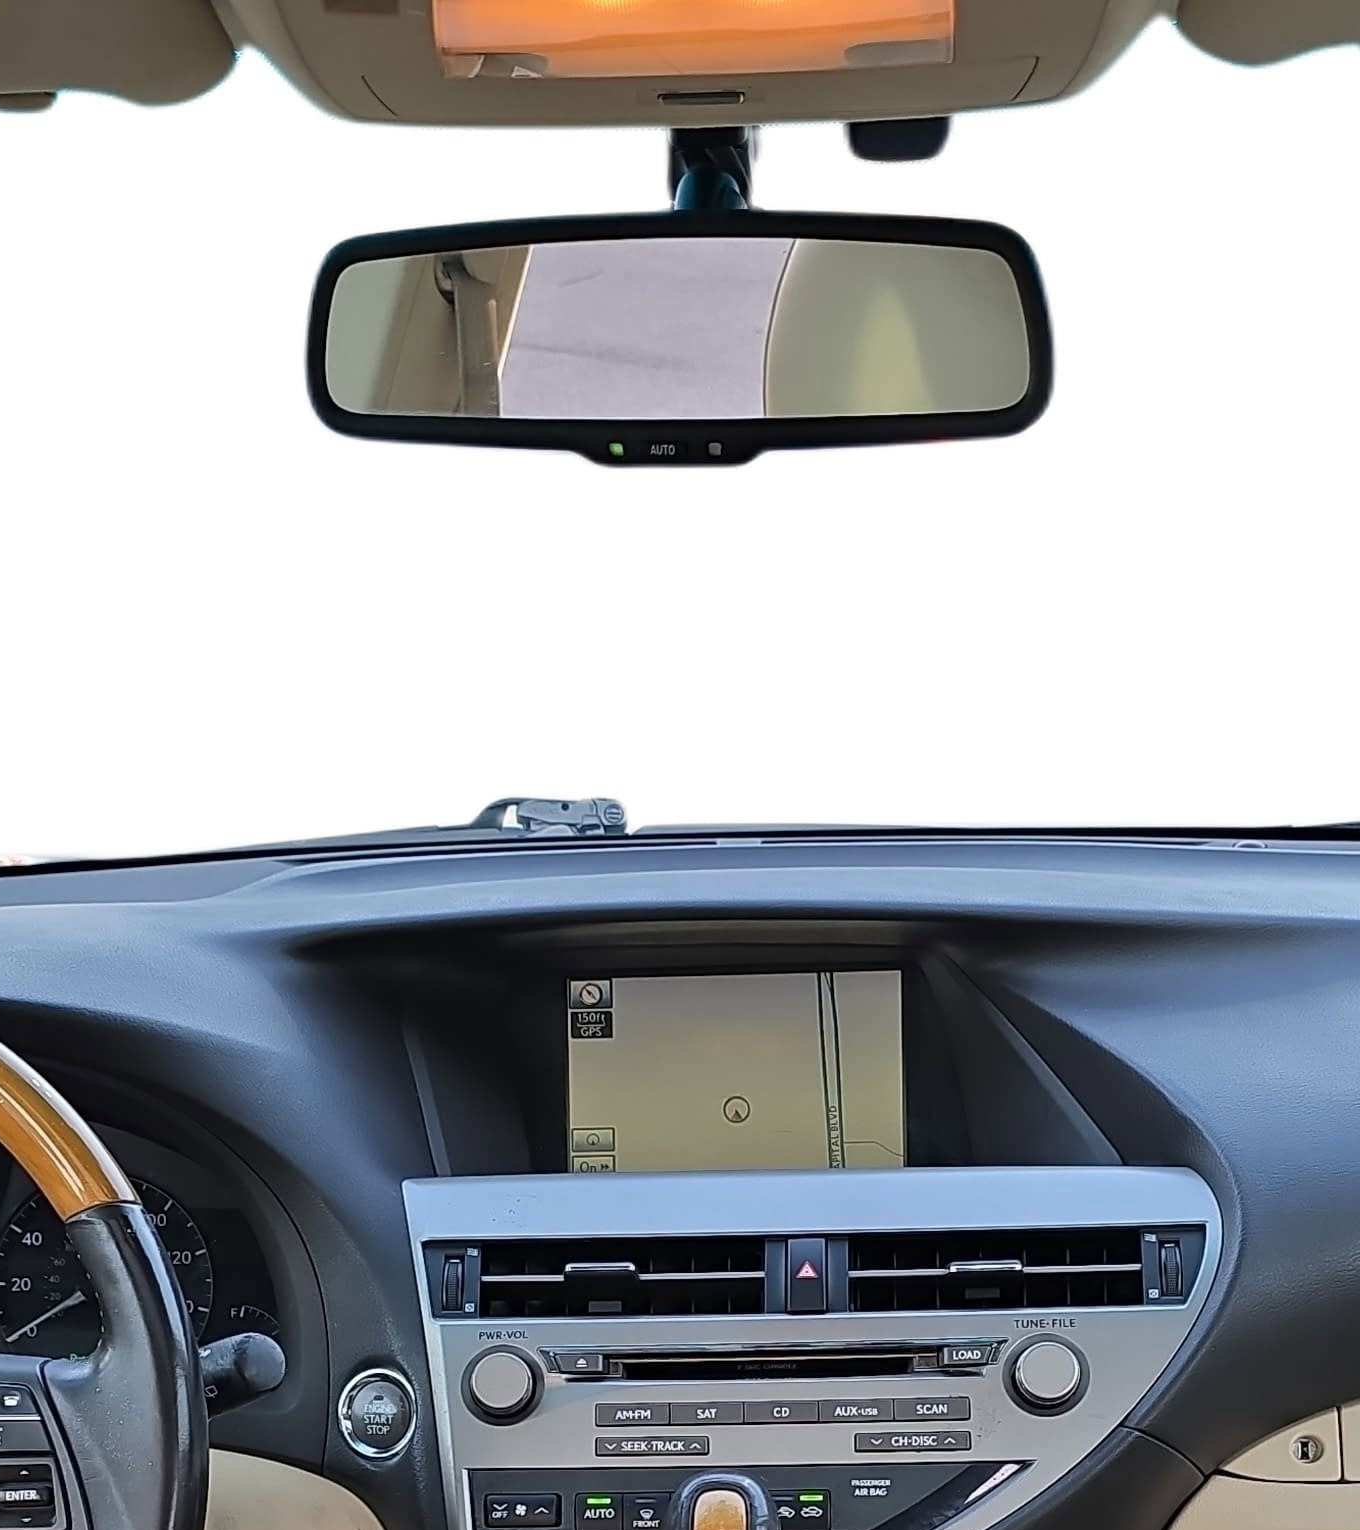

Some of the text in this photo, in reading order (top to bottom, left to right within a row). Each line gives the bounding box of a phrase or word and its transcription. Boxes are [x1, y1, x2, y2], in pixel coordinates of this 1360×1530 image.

[650, 444, 676, 456] AUTO
[577, 1012, 606, 1023] 150ft
[580, 1026, 602, 1037] GPS
[828, 1105, 839, 1131] BLVD
[21, 1231, 43, 1246] 40
[10, 1278, 32, 1292] 20
[230, 1308, 239, 1319] F
[952, 1350, 982, 1360] LOAD
[696, 1408, 718, 1420] SAT
[773, 1406, 791, 1418] CD
[915, 1403, 948, 1415] SCAN
[363, 1414, 395, 1424] START
[366, 1425, 391, 1435] STOP
[5, 1490, 40, 1501] ENTER
[492, 1511, 510, 1519] OFF
[584, 1508, 616, 1519] AUTO
[632, 1520, 660, 1528] FRONT
